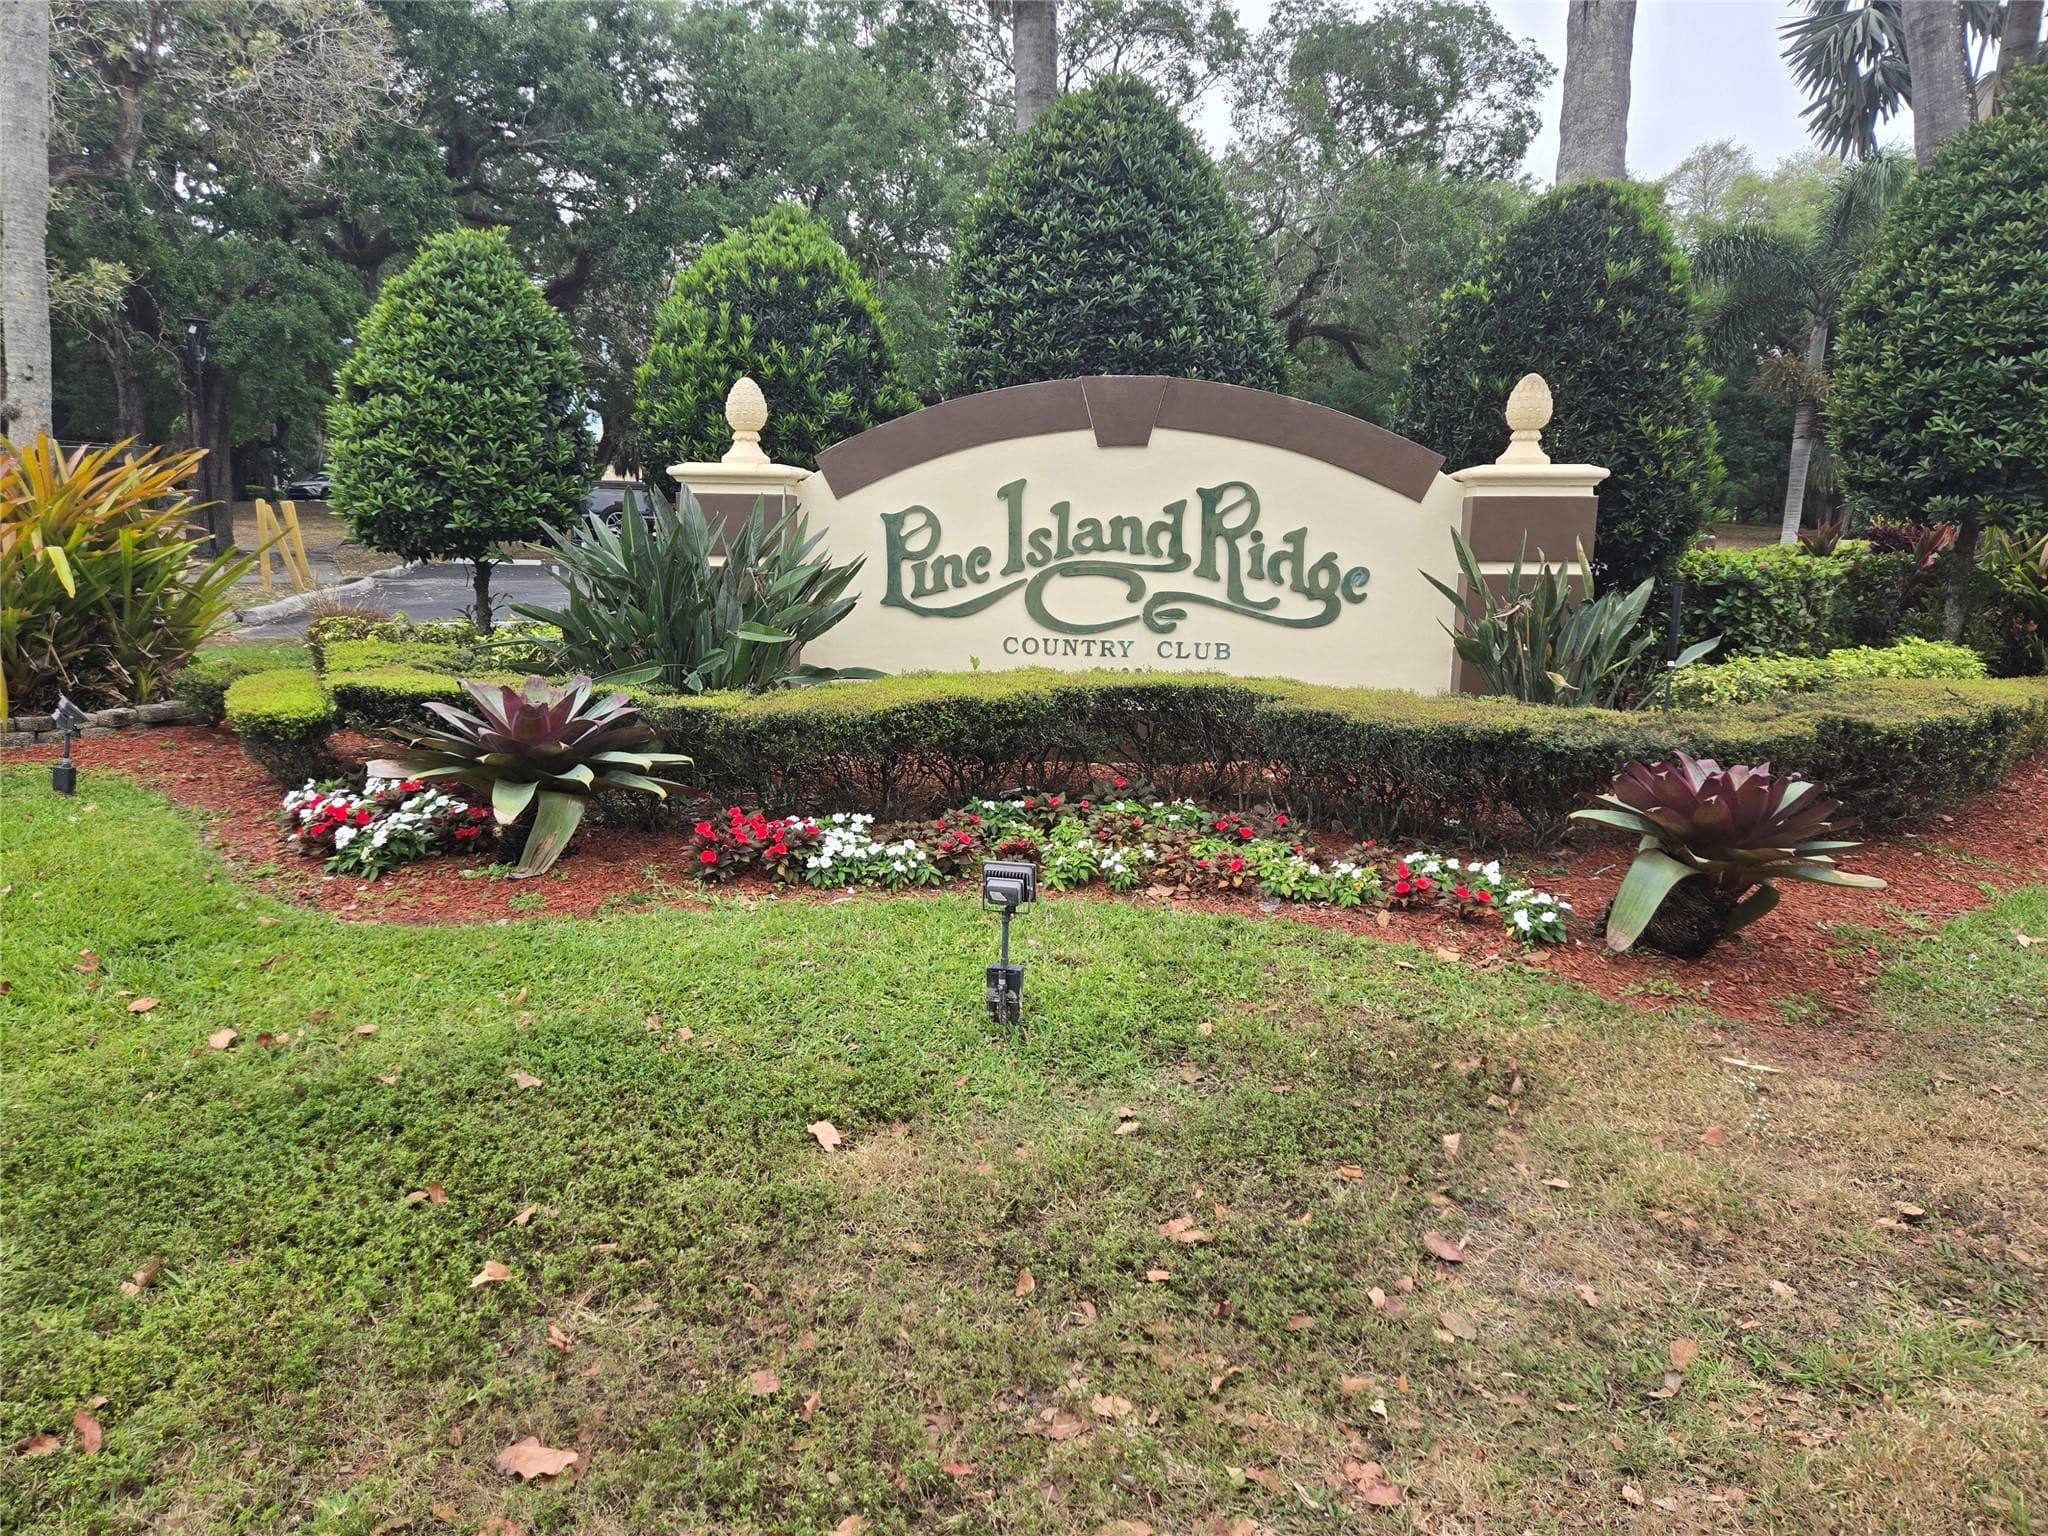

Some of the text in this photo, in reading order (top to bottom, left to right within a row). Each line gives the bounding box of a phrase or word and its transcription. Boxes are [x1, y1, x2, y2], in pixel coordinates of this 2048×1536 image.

[880, 478, 1371, 628] Pine Island Ridge
[1002, 636, 1232, 661] COUNTRY CLUB
